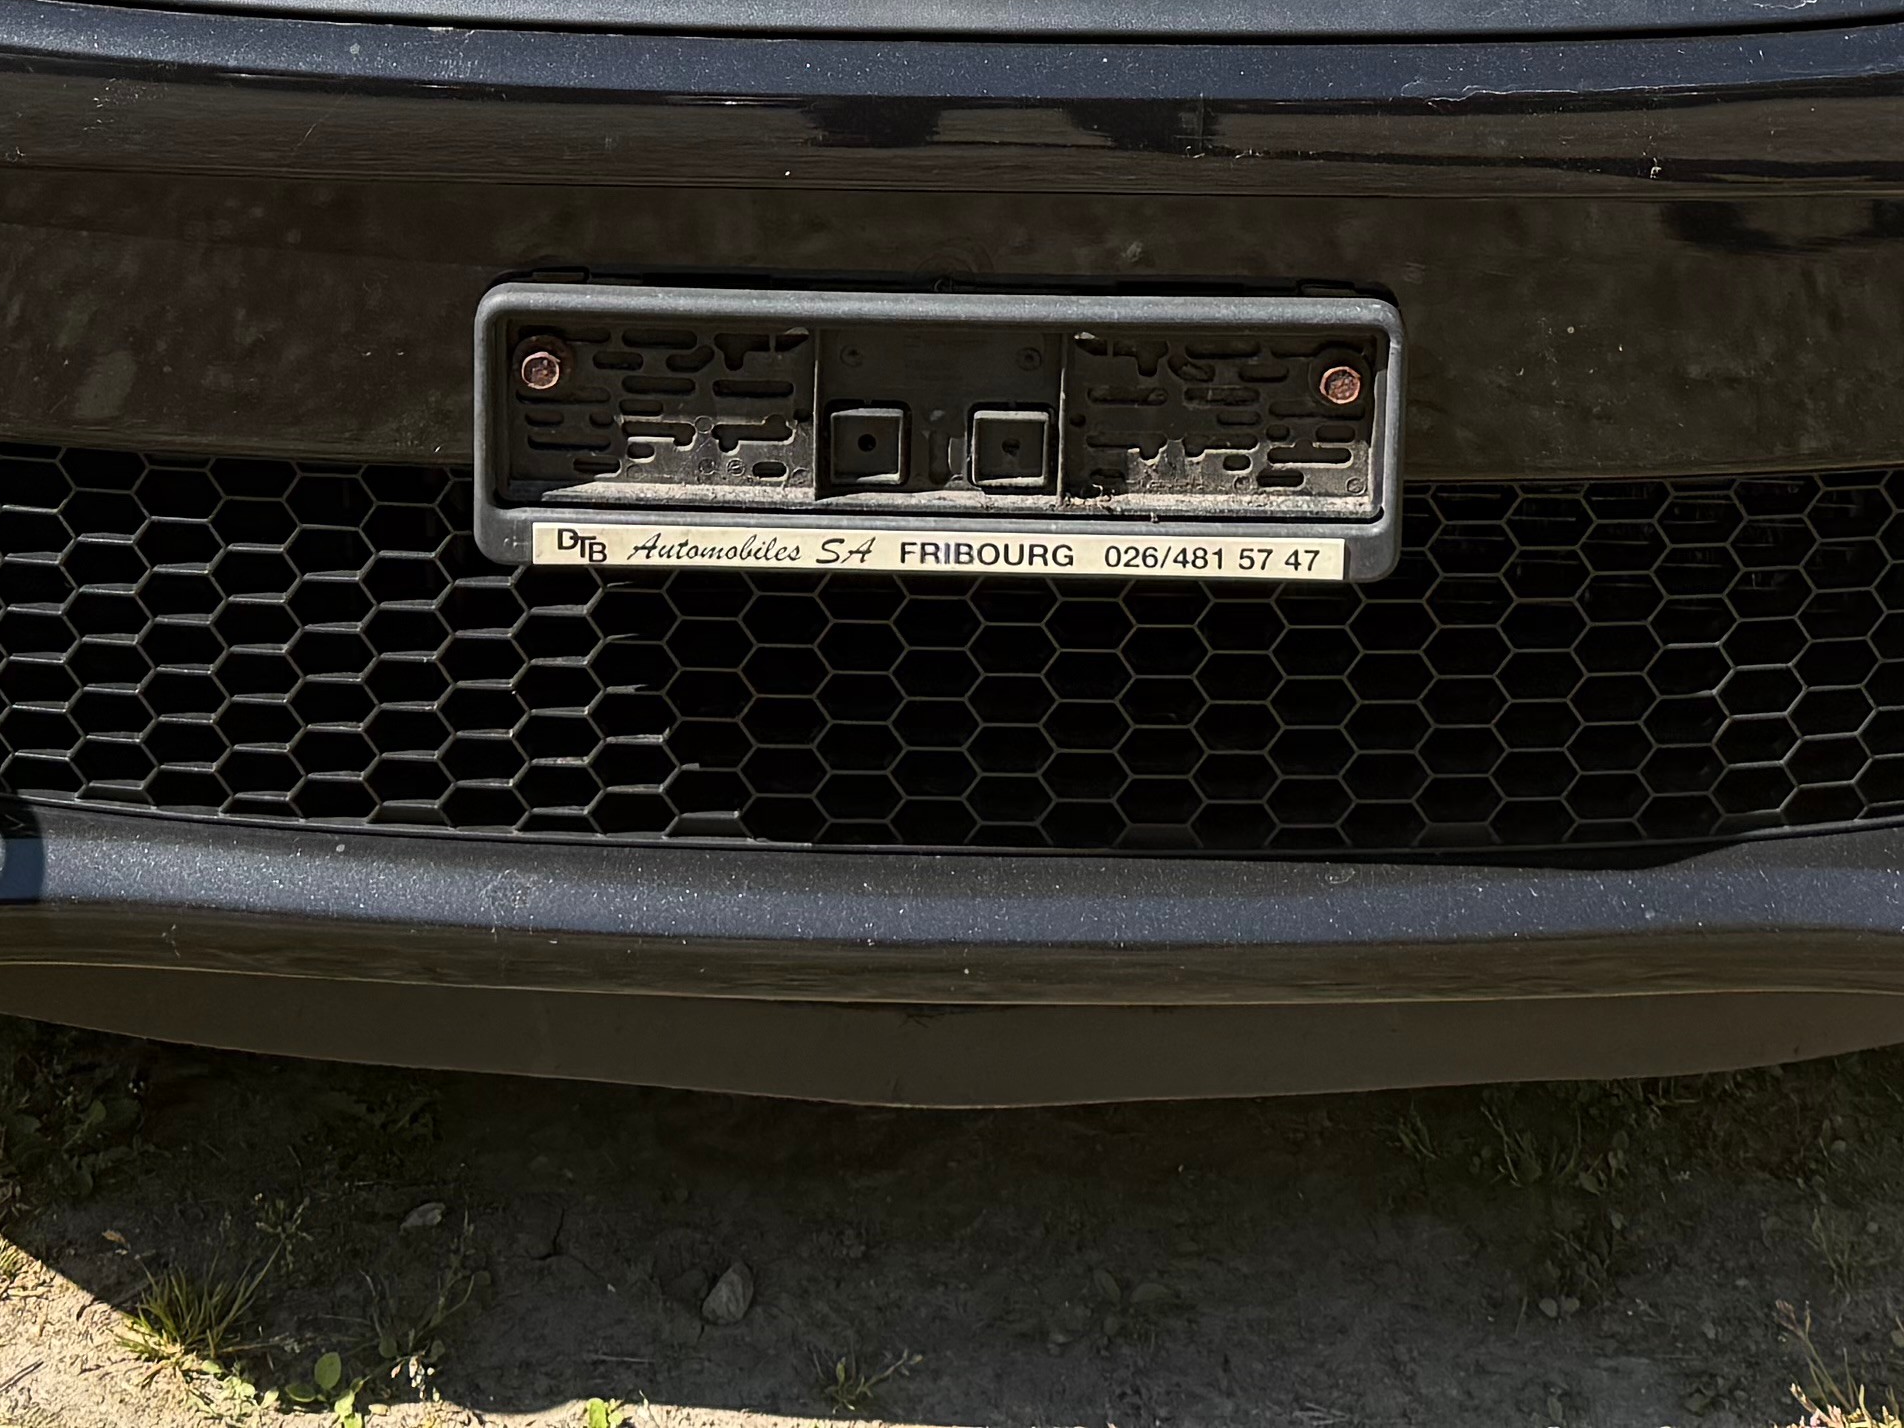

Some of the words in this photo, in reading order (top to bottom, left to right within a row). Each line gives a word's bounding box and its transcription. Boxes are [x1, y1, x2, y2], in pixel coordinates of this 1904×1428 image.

[627, 532, 802, 563] Automobiles
[816, 536, 877, 565] SA
[899, 541, 1075, 568] FRIBOURG
[1103, 546, 1225, 570] 026/481
[1238, 547, 1273, 571] 57
[1284, 548, 1321, 572] 47
